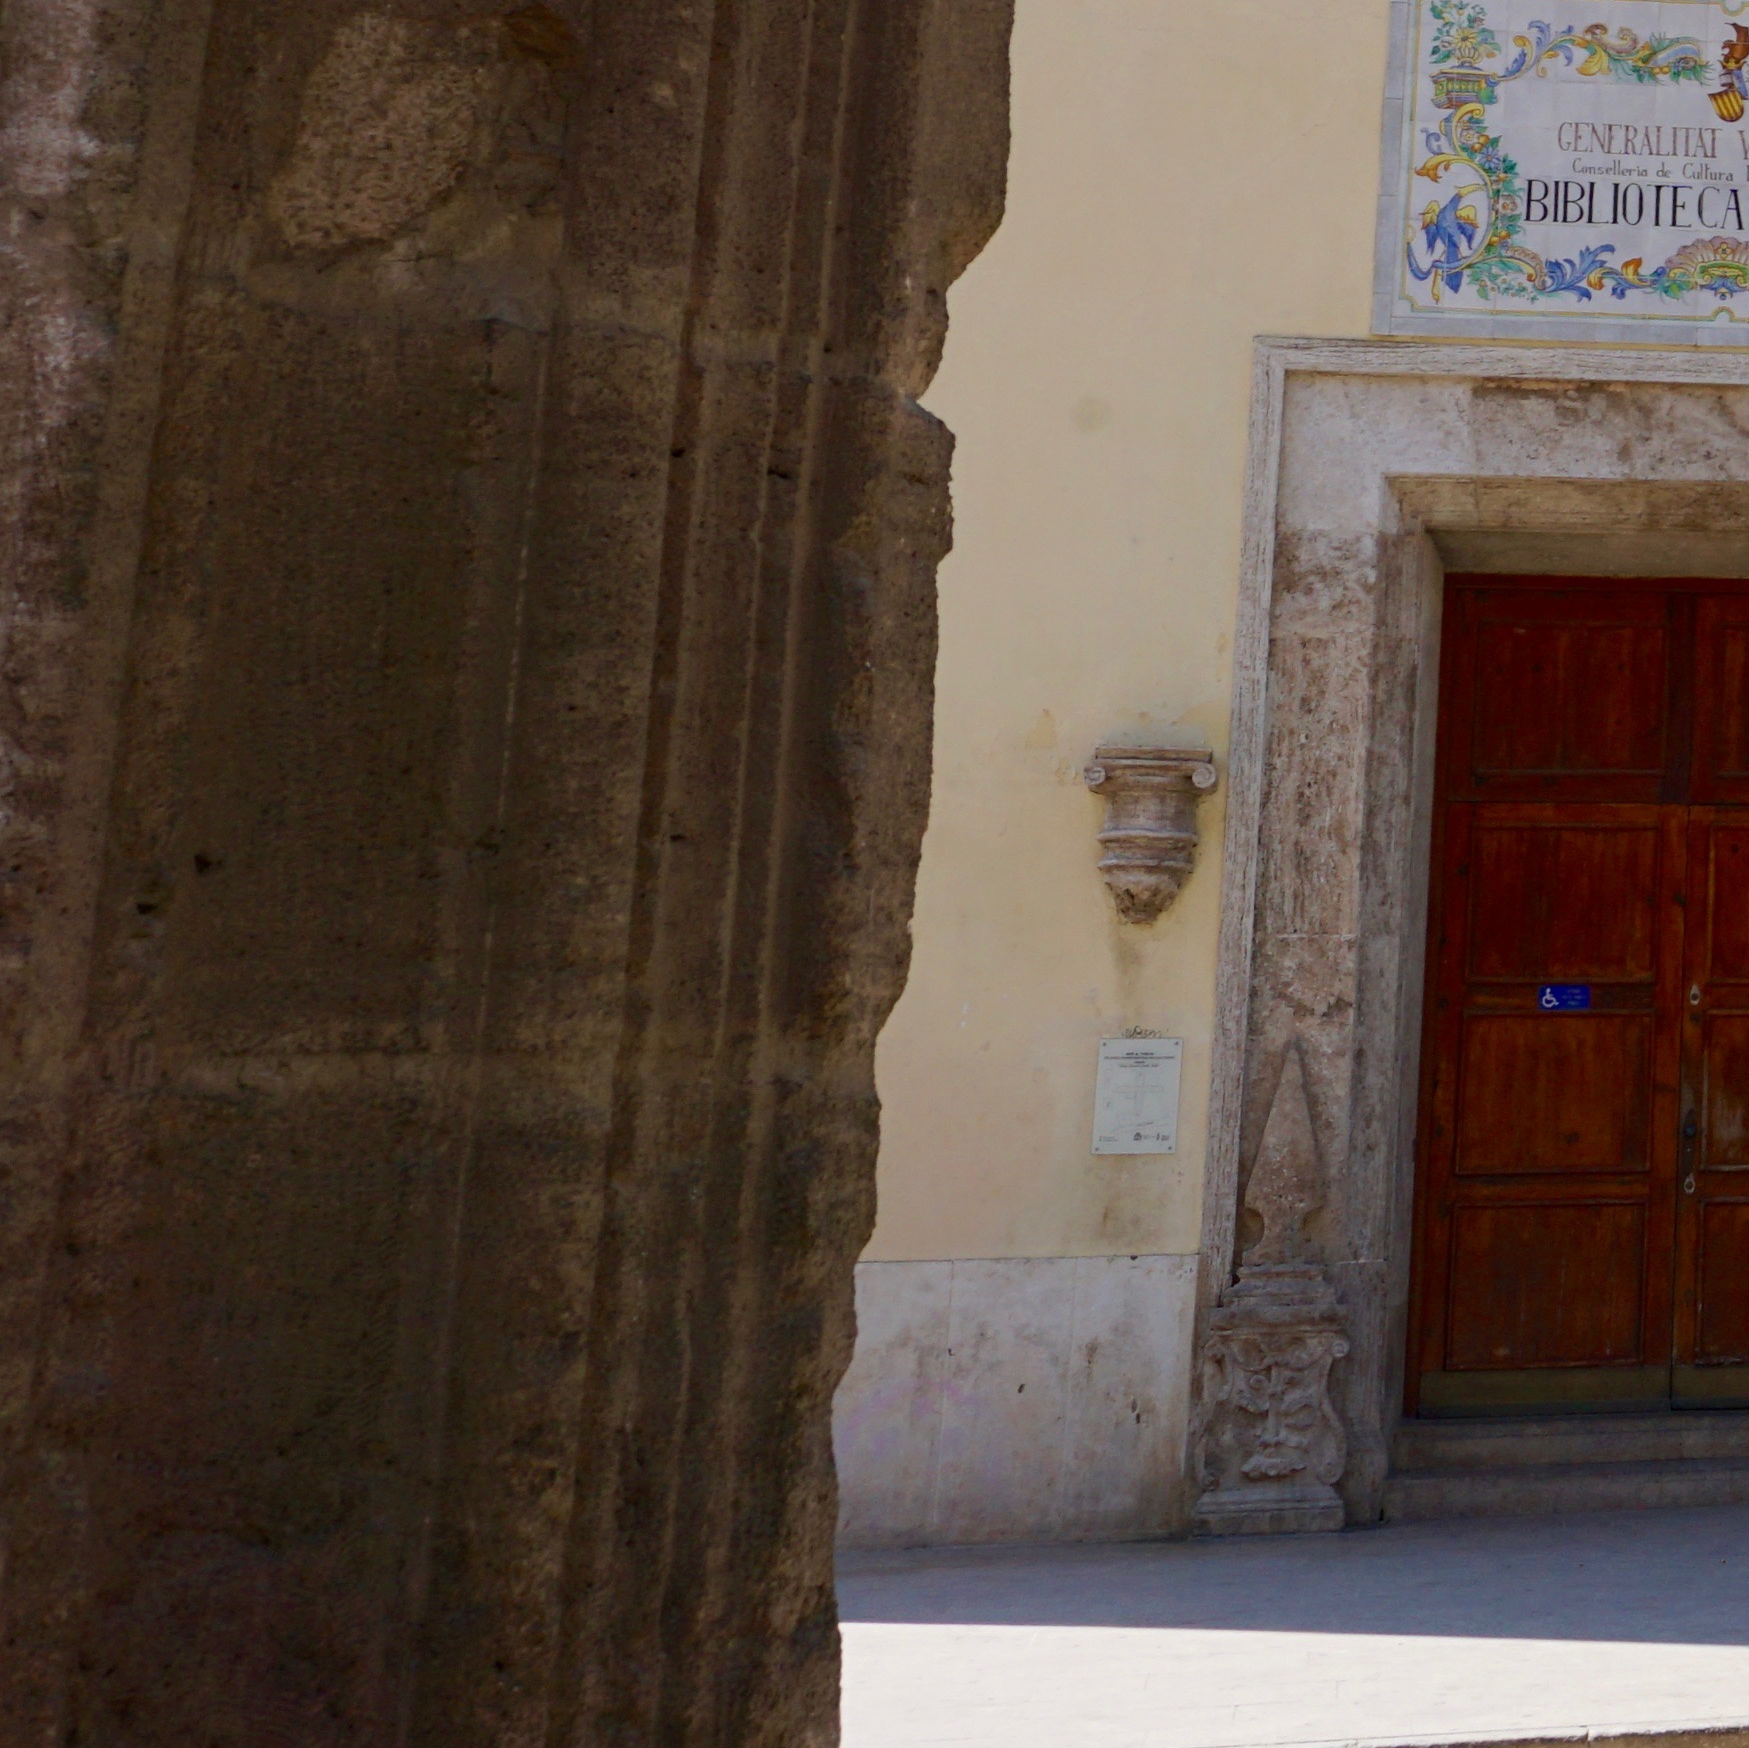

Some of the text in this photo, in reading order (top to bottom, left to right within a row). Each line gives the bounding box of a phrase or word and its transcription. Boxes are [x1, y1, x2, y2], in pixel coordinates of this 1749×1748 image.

[1557, 121, 1723, 159] GENERALITAT
[1572, 157, 1648, 178] Conselleria
[1656, 161, 1671, 179] de
[1682, 162, 1735, 183] Cultura
[1524, 178, 1744, 232] BIBLIOTECA
